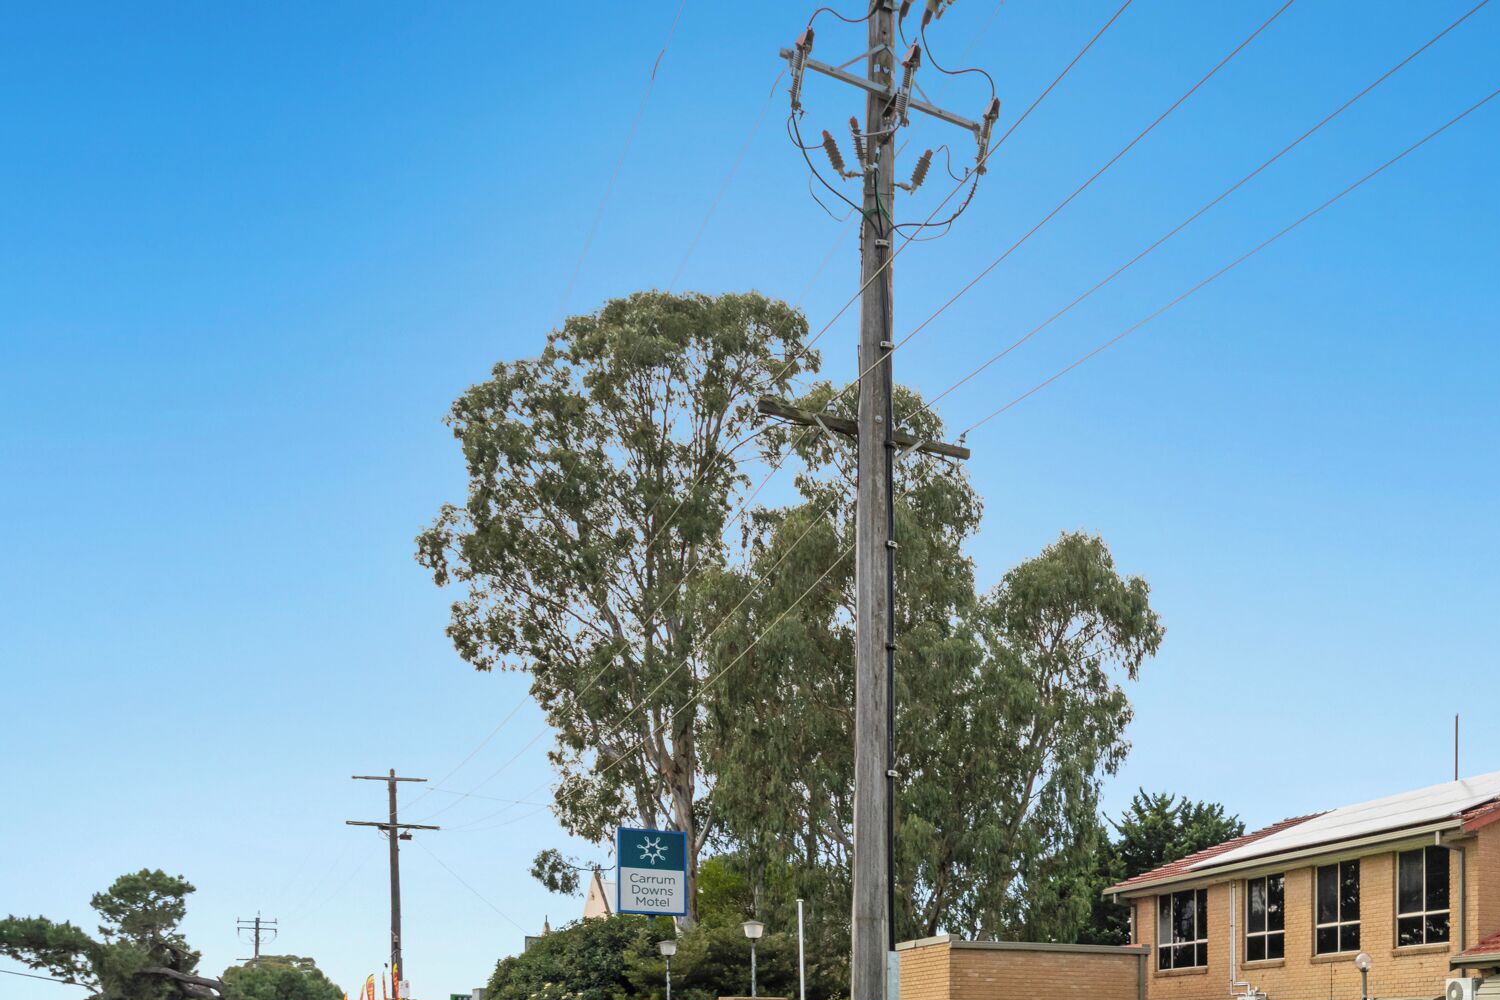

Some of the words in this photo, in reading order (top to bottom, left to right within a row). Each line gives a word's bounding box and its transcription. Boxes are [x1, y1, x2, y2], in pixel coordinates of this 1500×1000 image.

[629, 873, 676, 885] Carrum
[631, 884, 674, 896] Downs
[636, 897, 670, 907] Motel
